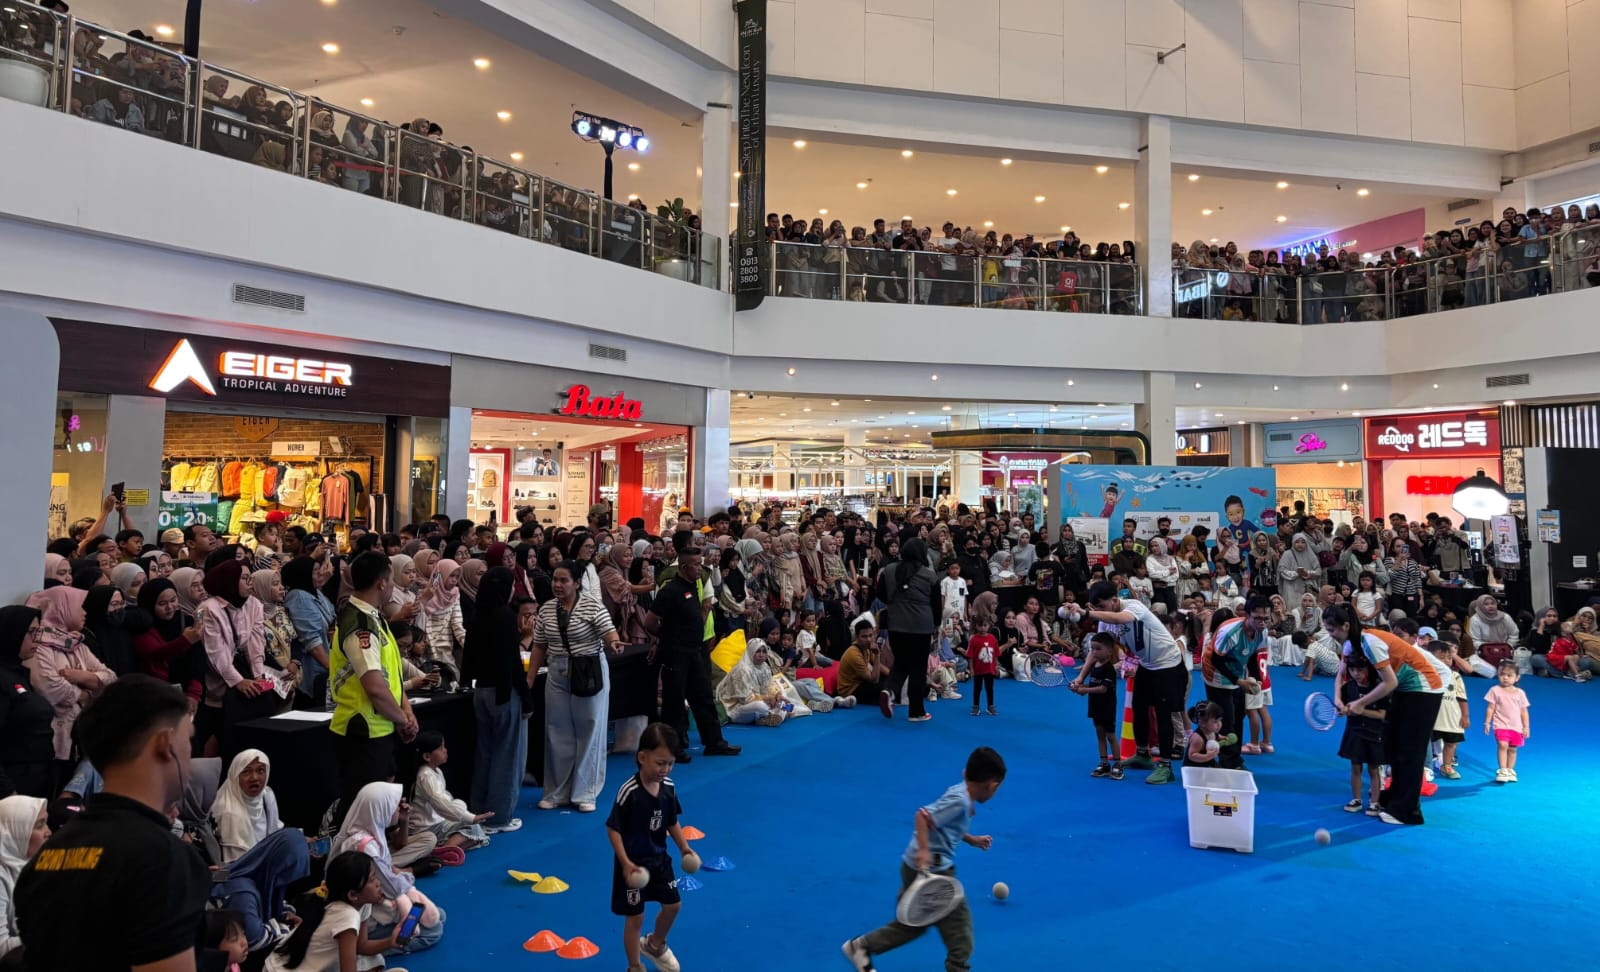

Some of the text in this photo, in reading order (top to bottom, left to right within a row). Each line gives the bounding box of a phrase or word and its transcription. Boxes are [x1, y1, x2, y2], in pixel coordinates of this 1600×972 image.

[752, 59, 760, 97] Luxury
[740, 43, 752, 165] Step Into The Next Icon
[752, 99, 760, 135] Urban
[740, 256, 758, 266] 0813
[740, 266, 758, 275] 2800
[740, 274, 758, 284] 3800
[219, 352, 352, 385] EIGER
[224, 377, 347, 397] TROPICAL ADVENTURE
[561, 384, 643, 420] Bata
[1378, 430, 1415, 449] REDDOG
[1418, 421, 1488, 448] 레드독
